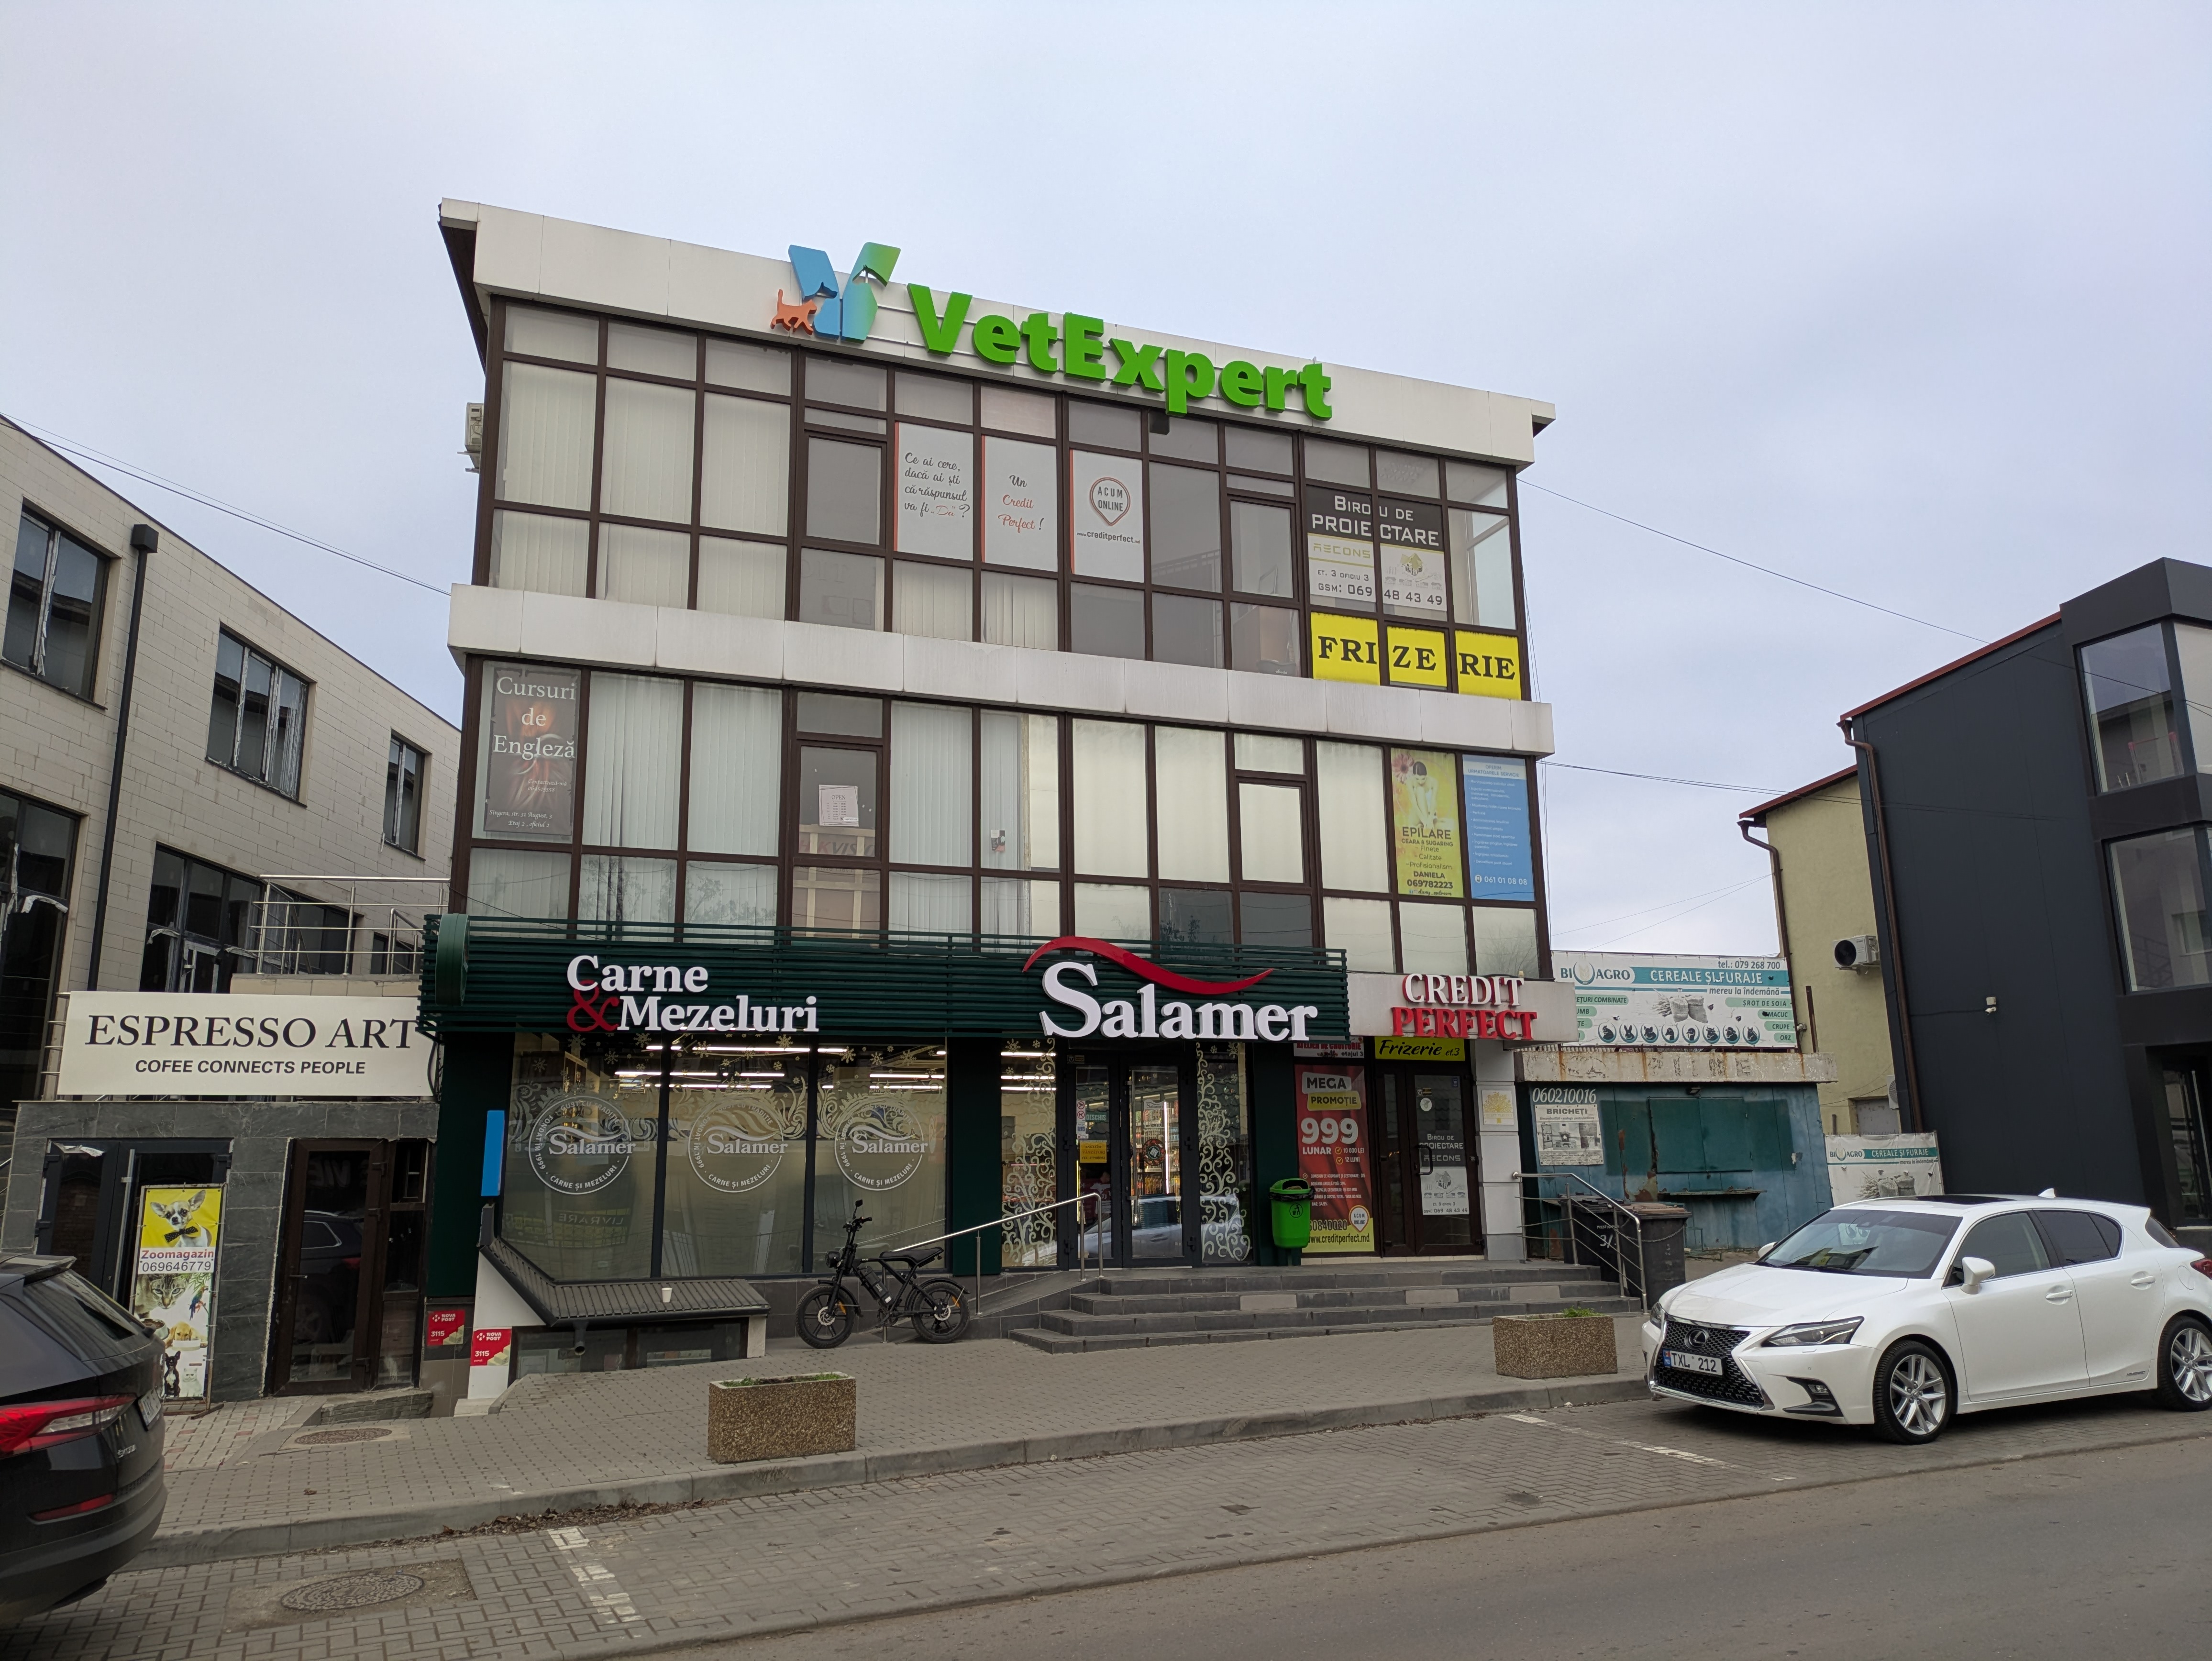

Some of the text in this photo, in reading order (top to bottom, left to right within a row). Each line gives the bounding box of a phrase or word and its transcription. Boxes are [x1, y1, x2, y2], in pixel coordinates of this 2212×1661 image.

[907, 282, 1332, 421] VetExpert
[905, 452, 960, 472] Ce ai cere,
[905, 467, 929, 479] dacă
[933, 473, 944, 482] ai
[1009, 475, 1027, 488] Un
[905, 485, 967, 501] că răspunsul
[1097, 486, 1123, 498] ACUM
[920, 502, 929, 517] fi
[1003, 494, 1034, 509] Credit
[1097, 499, 1123, 512] ONLINE
[1395, 508, 1414, 521] DE
[997, 514, 1035, 533] Perfect
[1077, 531, 1140, 544] www.creditperfect.md
[1318, 583, 1442, 606] GSM: 069 48 43 49
[497, 676, 575, 700] Cursuri
[521, 708, 546, 727] de
[493, 734, 575, 761] Engleză
[1402, 826, 1451, 840] EPILARE
[1413, 871, 1445, 879] DANIELA
[1407, 879, 1453, 889] 069782223
[1718, 960, 1733, 968] tel.:
[1735, 961, 1749, 969] 079
[1750, 961, 1765, 969] 268
[566, 955, 709, 993] Carne
[1650, 970, 1702, 982] CEREALE
[1719, 972, 1763, 984] FURAJE
[1403, 973, 1525, 1006] CREDIT
[1735, 986, 1741, 995] la
[1743, 986, 1780, 996] îndemână
[1039, 960, 1317, 1042] Salamer
[616, 995, 820, 1032] Mezeluri
[85, 1015, 419, 1049] ESPRESSO ART
[1391, 1007, 1537, 1041] PERFECT
[1379, 1039, 1460, 1057] Frizerie et.3
[135, 1059, 366, 1075] COFEE CONNECTS PEOPLE
[1306, 1077, 1347, 1089] MEGA
[1311, 1096, 1357, 1106] PROMOȚIE
[1532, 1087, 1597, 1104] 060210016
[560, 1102, 579, 1112] GUST
[536, 1115, 553, 1141] FONDAT
[1301, 1117, 1359, 1145] 999
[549, 1133, 636, 1154] Salamer
[707, 1133, 788, 1154] Salamer
[852, 1134, 928, 1153] Salamer
[1302, 1147, 1332, 1155] LUNAR
[535, 1153, 546, 1170] 1999
[694, 1152, 705, 1169] 1999
[840, 1152, 851, 1167] 1999
[1871, 1149, 1898, 1157] CEREALE
[550, 1175, 573, 1189] CARNE
[585, 1164, 617, 1188] MEZELURI
[708, 1174, 730, 1187] CARNE
[741, 1164, 771, 1186] MEZELURI
[854, 1173, 874, 1185] CARNE
[885, 1163, 913, 1185] MEZELURI
[141, 1249, 214, 1261] Zoomagazin
[142, 1261, 212, 1272] 069646779
[1671, 1352, 1690, 1368] TXL
[1698, 1357, 1717, 1373] 212
